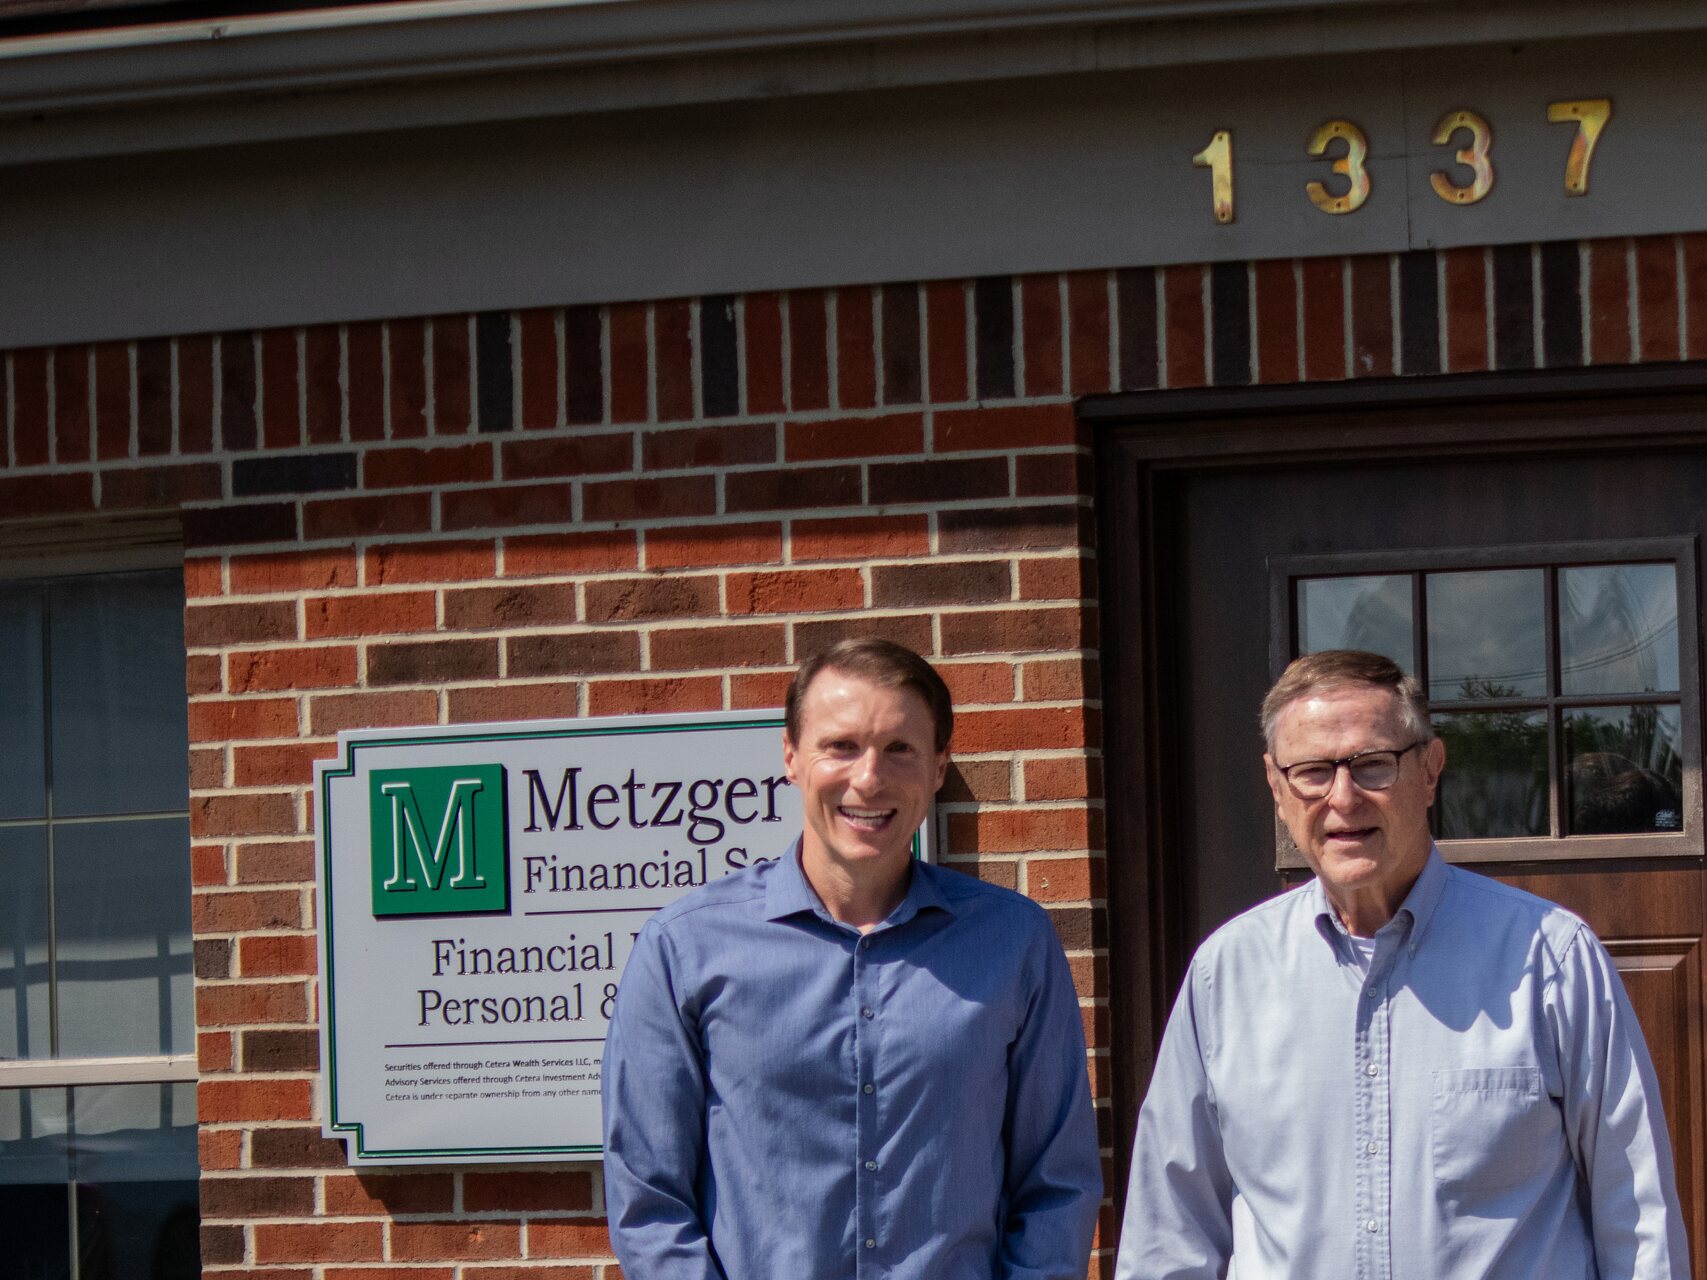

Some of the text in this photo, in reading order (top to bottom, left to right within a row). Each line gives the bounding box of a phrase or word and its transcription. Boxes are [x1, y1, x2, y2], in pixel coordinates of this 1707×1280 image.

[522, 767, 791, 845] Metzger
[382, 779, 486, 892] M
[523, 848, 707, 893] Financial
[431, 932, 617, 976] Financial
[417, 983, 586, 1026] Personal
[384, 1063, 421, 1072] Securities
[423, 1062, 451, 1070] offered
[453, 1061, 482, 1070] through
[485, 1060, 510, 1069] Cetera
[512, 1059, 539, 1068] Wealth
[541, 1058, 574, 1067] Services
[385, 1078, 418, 1087] Advisory
[420, 1077, 451, 1085] Services
[453, 1076, 480, 1084] offered
[482, 1075, 513, 1084] through
[515, 1074, 540, 1083] Cetera
[542, 1073, 585, 1082] Investment
[385, 1093, 411, 1102] Cetera
[412, 1093, 418, 1101] is
[420, 1092, 443, 1100] under
[445, 1091, 477, 1101] separate
[480, 1090, 520, 1099] ownership
[522, 1089, 541, 1097] from
[542, 1090, 557, 1098] any
[558, 1088, 579, 1097] other
